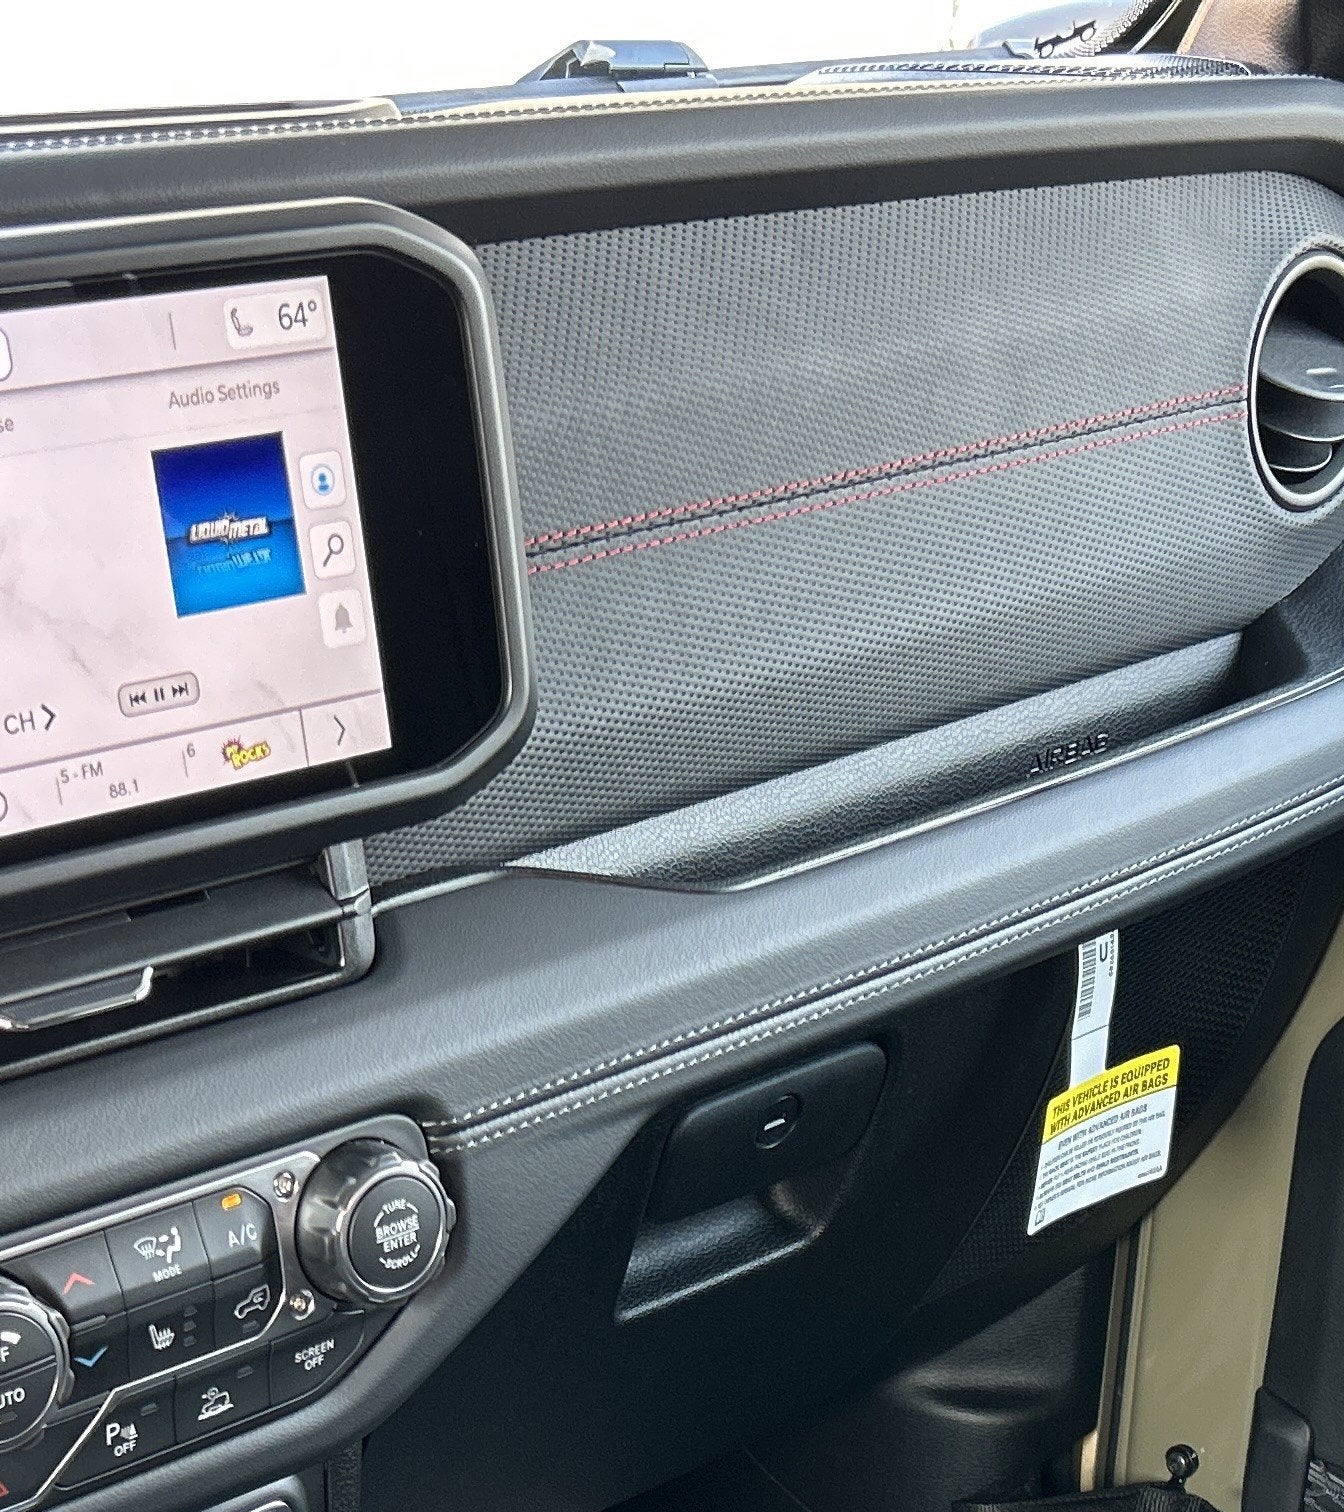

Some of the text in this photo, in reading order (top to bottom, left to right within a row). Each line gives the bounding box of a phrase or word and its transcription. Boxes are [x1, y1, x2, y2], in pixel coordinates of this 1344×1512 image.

[168, 378, 281, 410] Audio Settings
[4, 711, 36, 736] CH
[186, 744, 196, 758] 6
[80, 760, 104, 779] FM
[108, 778, 140, 799] 88.1
[1052, 1057, 1170, 1119] THIS VEHICLE IS EQUIPPED
[1050, 1073, 1169, 1136] WITH ADVANCED AIR BAGS
[381, 1198, 407, 1216] TUNE
[228, 1222, 258, 1249] A/C
[375, 1214, 420, 1240] BROWSE
[383, 1231, 418, 1253] ENTER
[384, 1250, 419, 1270] SCROLL
[153, 1263, 183, 1283] MODE
[294, 1338, 336, 1366] SCREEN
[304, 1354, 326, 1371] OFF
[113, 1437, 137, 1457] OFF
